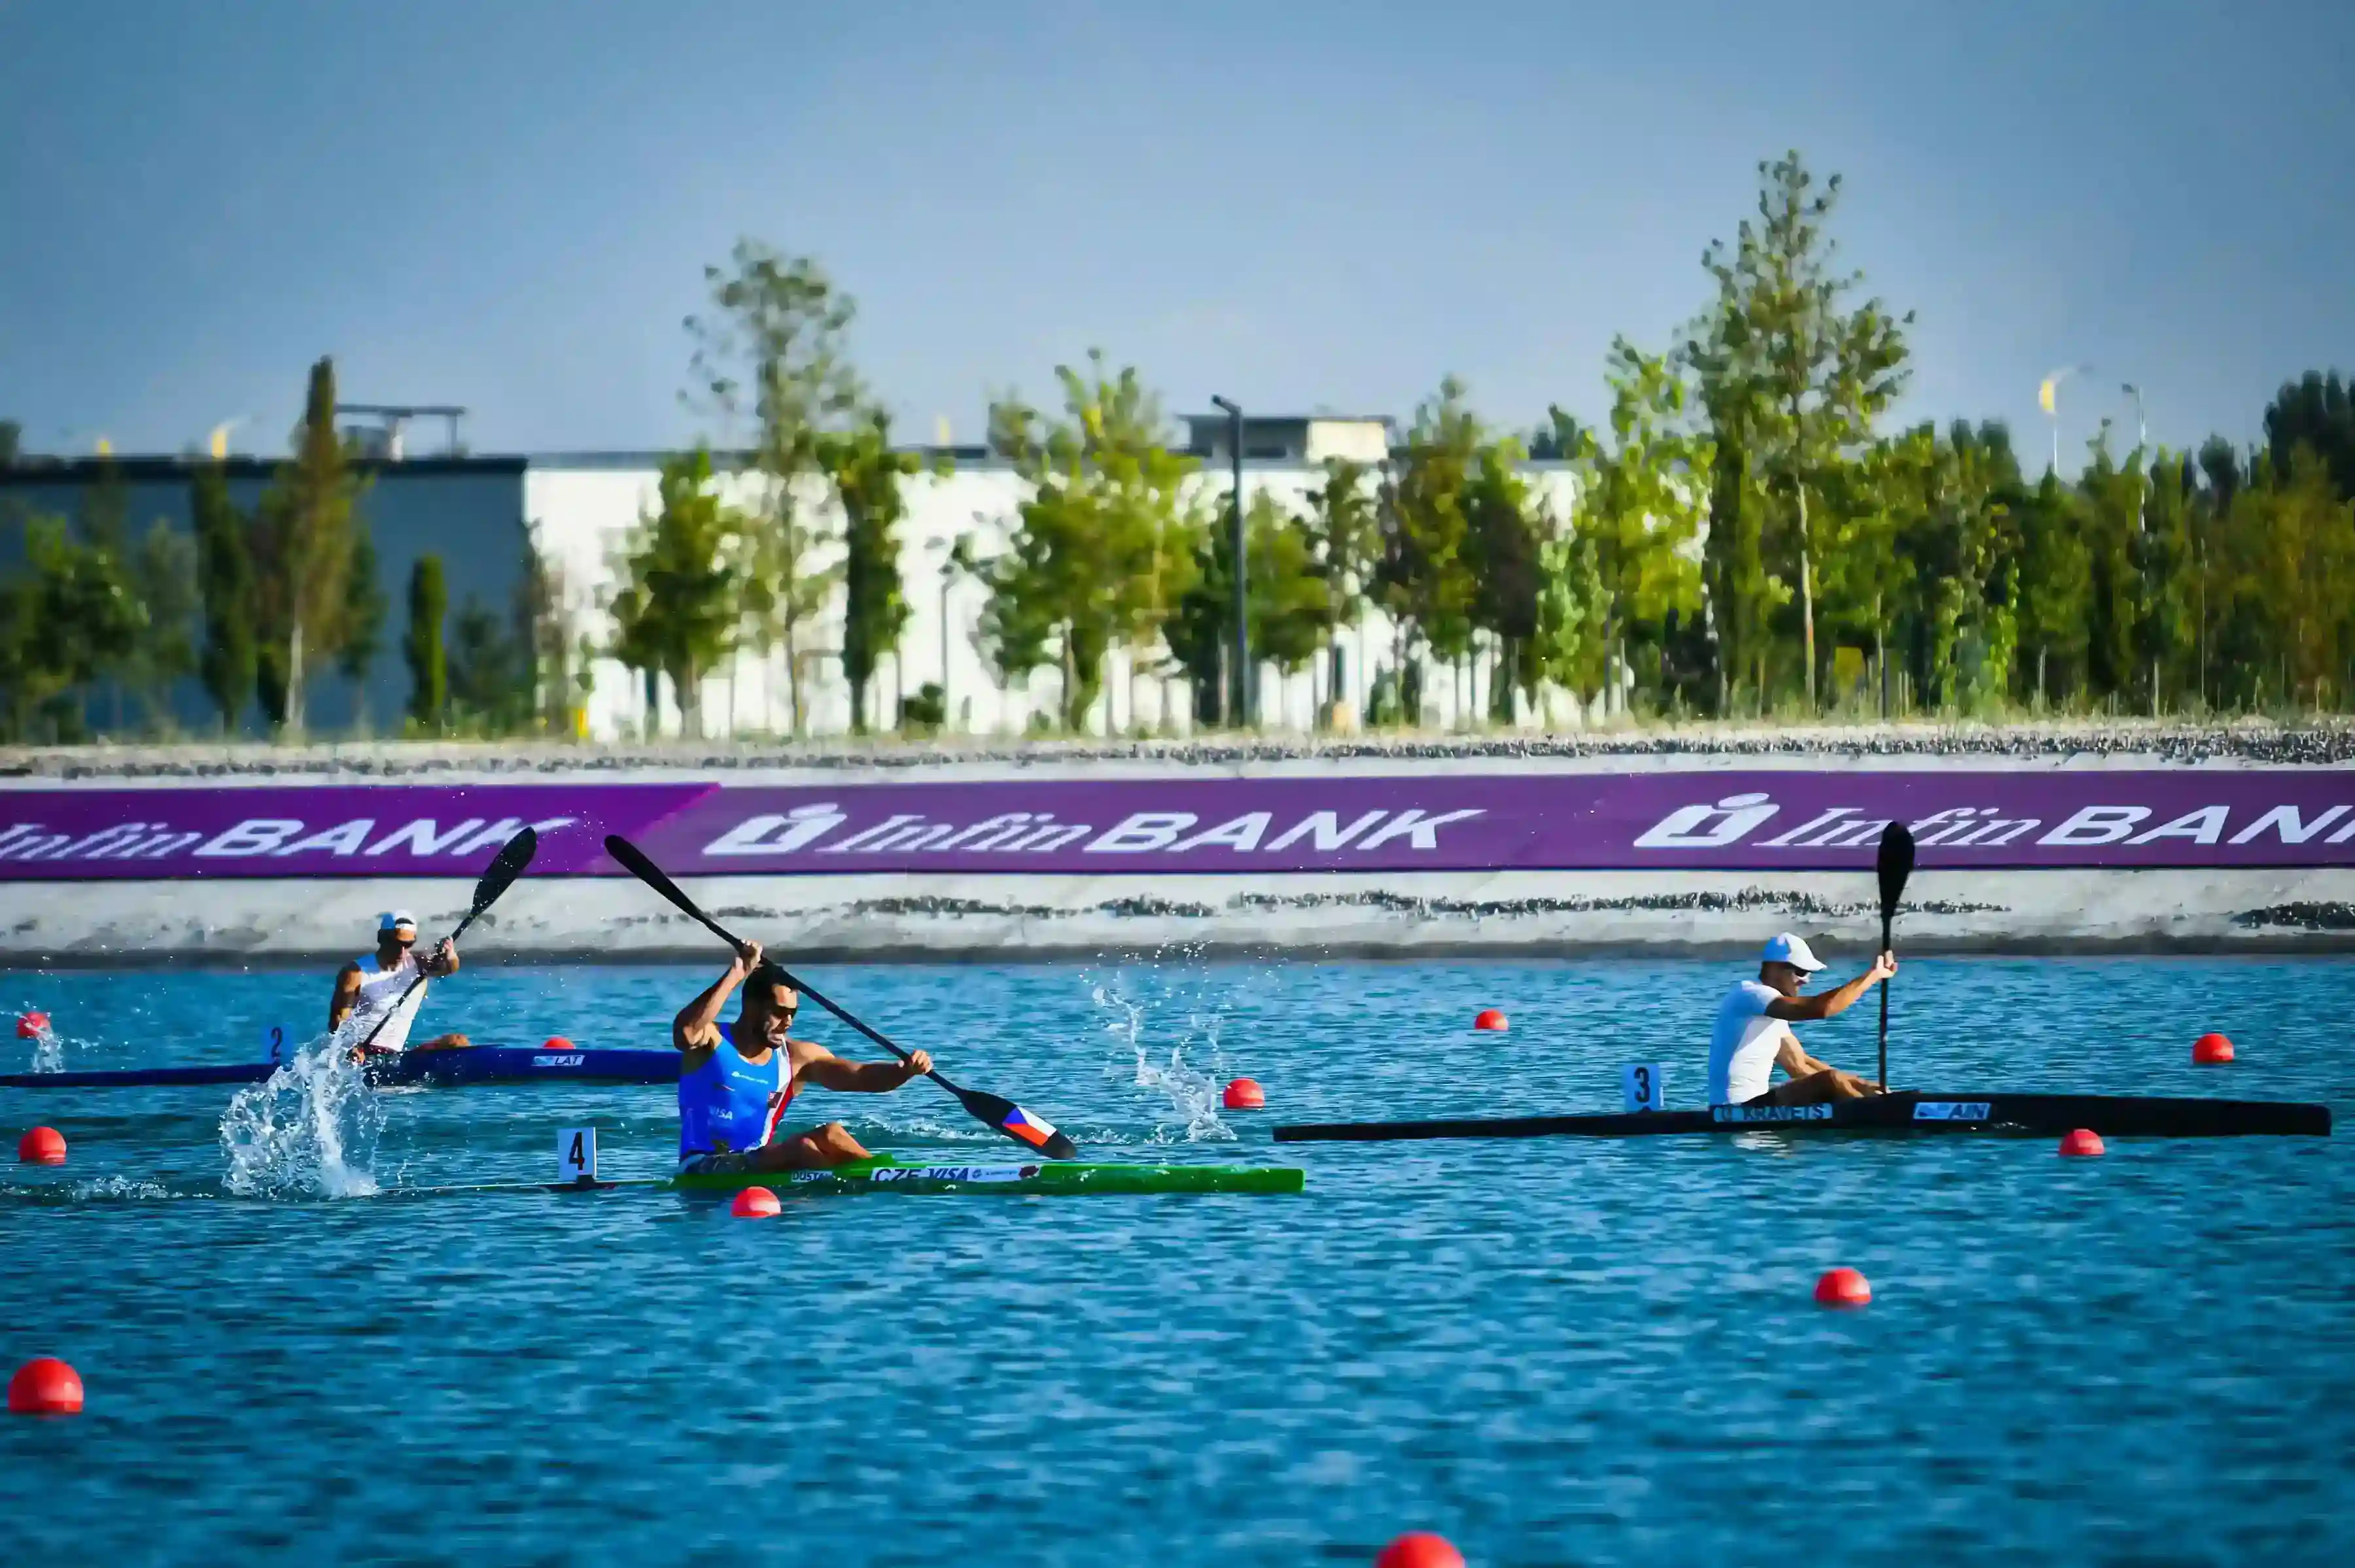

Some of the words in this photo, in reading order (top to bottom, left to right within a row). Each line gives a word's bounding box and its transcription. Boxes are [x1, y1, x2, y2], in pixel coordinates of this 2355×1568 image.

[1751, 805, 2355, 846] InfinBAN
[270, 1027, 283, 1058] 2
[555, 1055, 582, 1065] LAT
[1634, 1067, 1650, 1103] 3
[707, 1105, 733, 1121] VISA
[568, 1132, 585, 1170] 4
[875, 1168, 922, 1182] CZE
[927, 1167, 969, 1180] VISA
